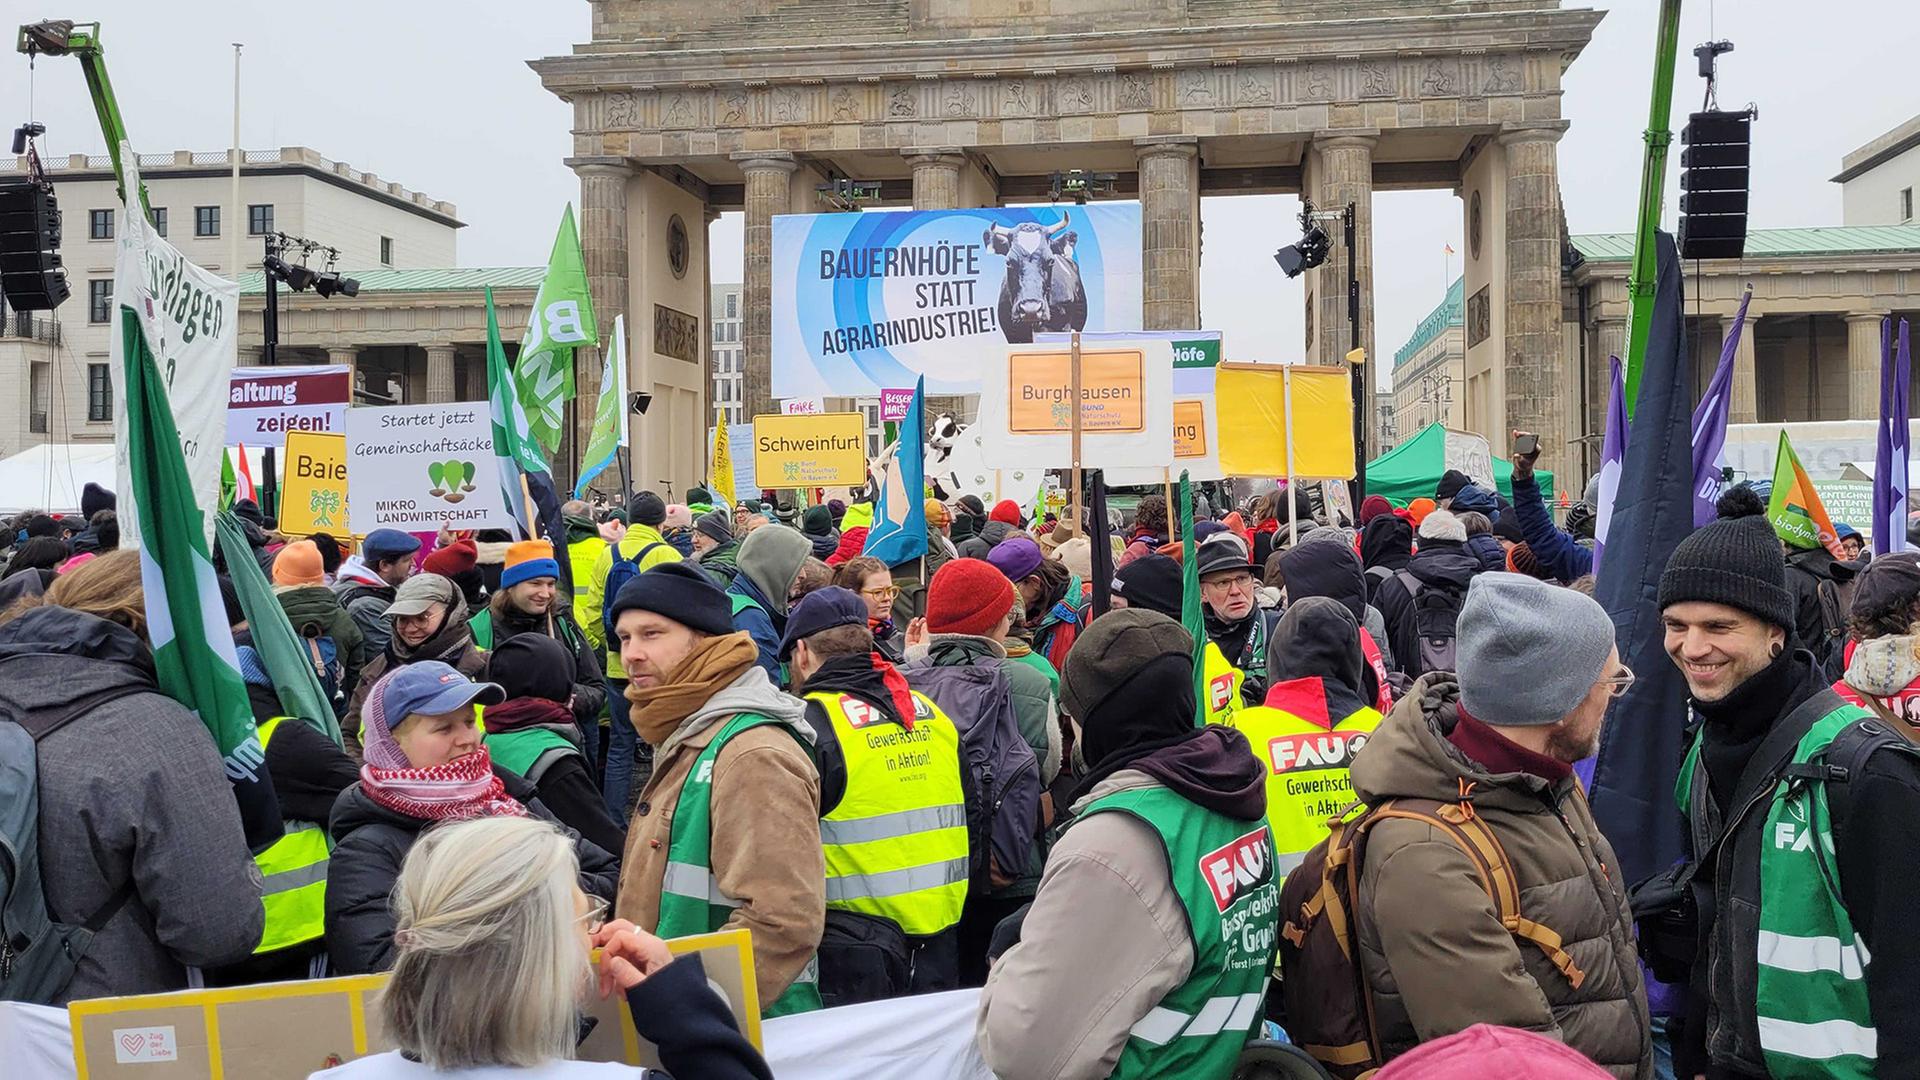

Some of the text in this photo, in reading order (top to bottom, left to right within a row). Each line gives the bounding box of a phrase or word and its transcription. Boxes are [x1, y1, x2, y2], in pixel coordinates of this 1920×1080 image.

[820, 240, 980, 279] BAUERNHÖFE
[915, 279, 977, 309] STATT
[822, 307, 997, 355] AGRARINDUSTRIE!
[229, 381, 298, 405] altung
[1022, 384, 1131, 403] Burghausen
[256, 411, 331, 432] zeigen!
[381, 410, 476, 429] Startet jetzt
[1173, 422, 1197, 440] ing
[760, 435, 860, 452] Schweinfurt
[376, 499, 417, 511] MIKRO
[376, 508, 489, 523] LANDWIRTSCHAFT
[886, 750, 931, 771] in Aktion!
[1272, 737, 1345, 770] FAU
[1304, 801, 1314, 816] in
[1209, 840, 1264, 900] FAU
